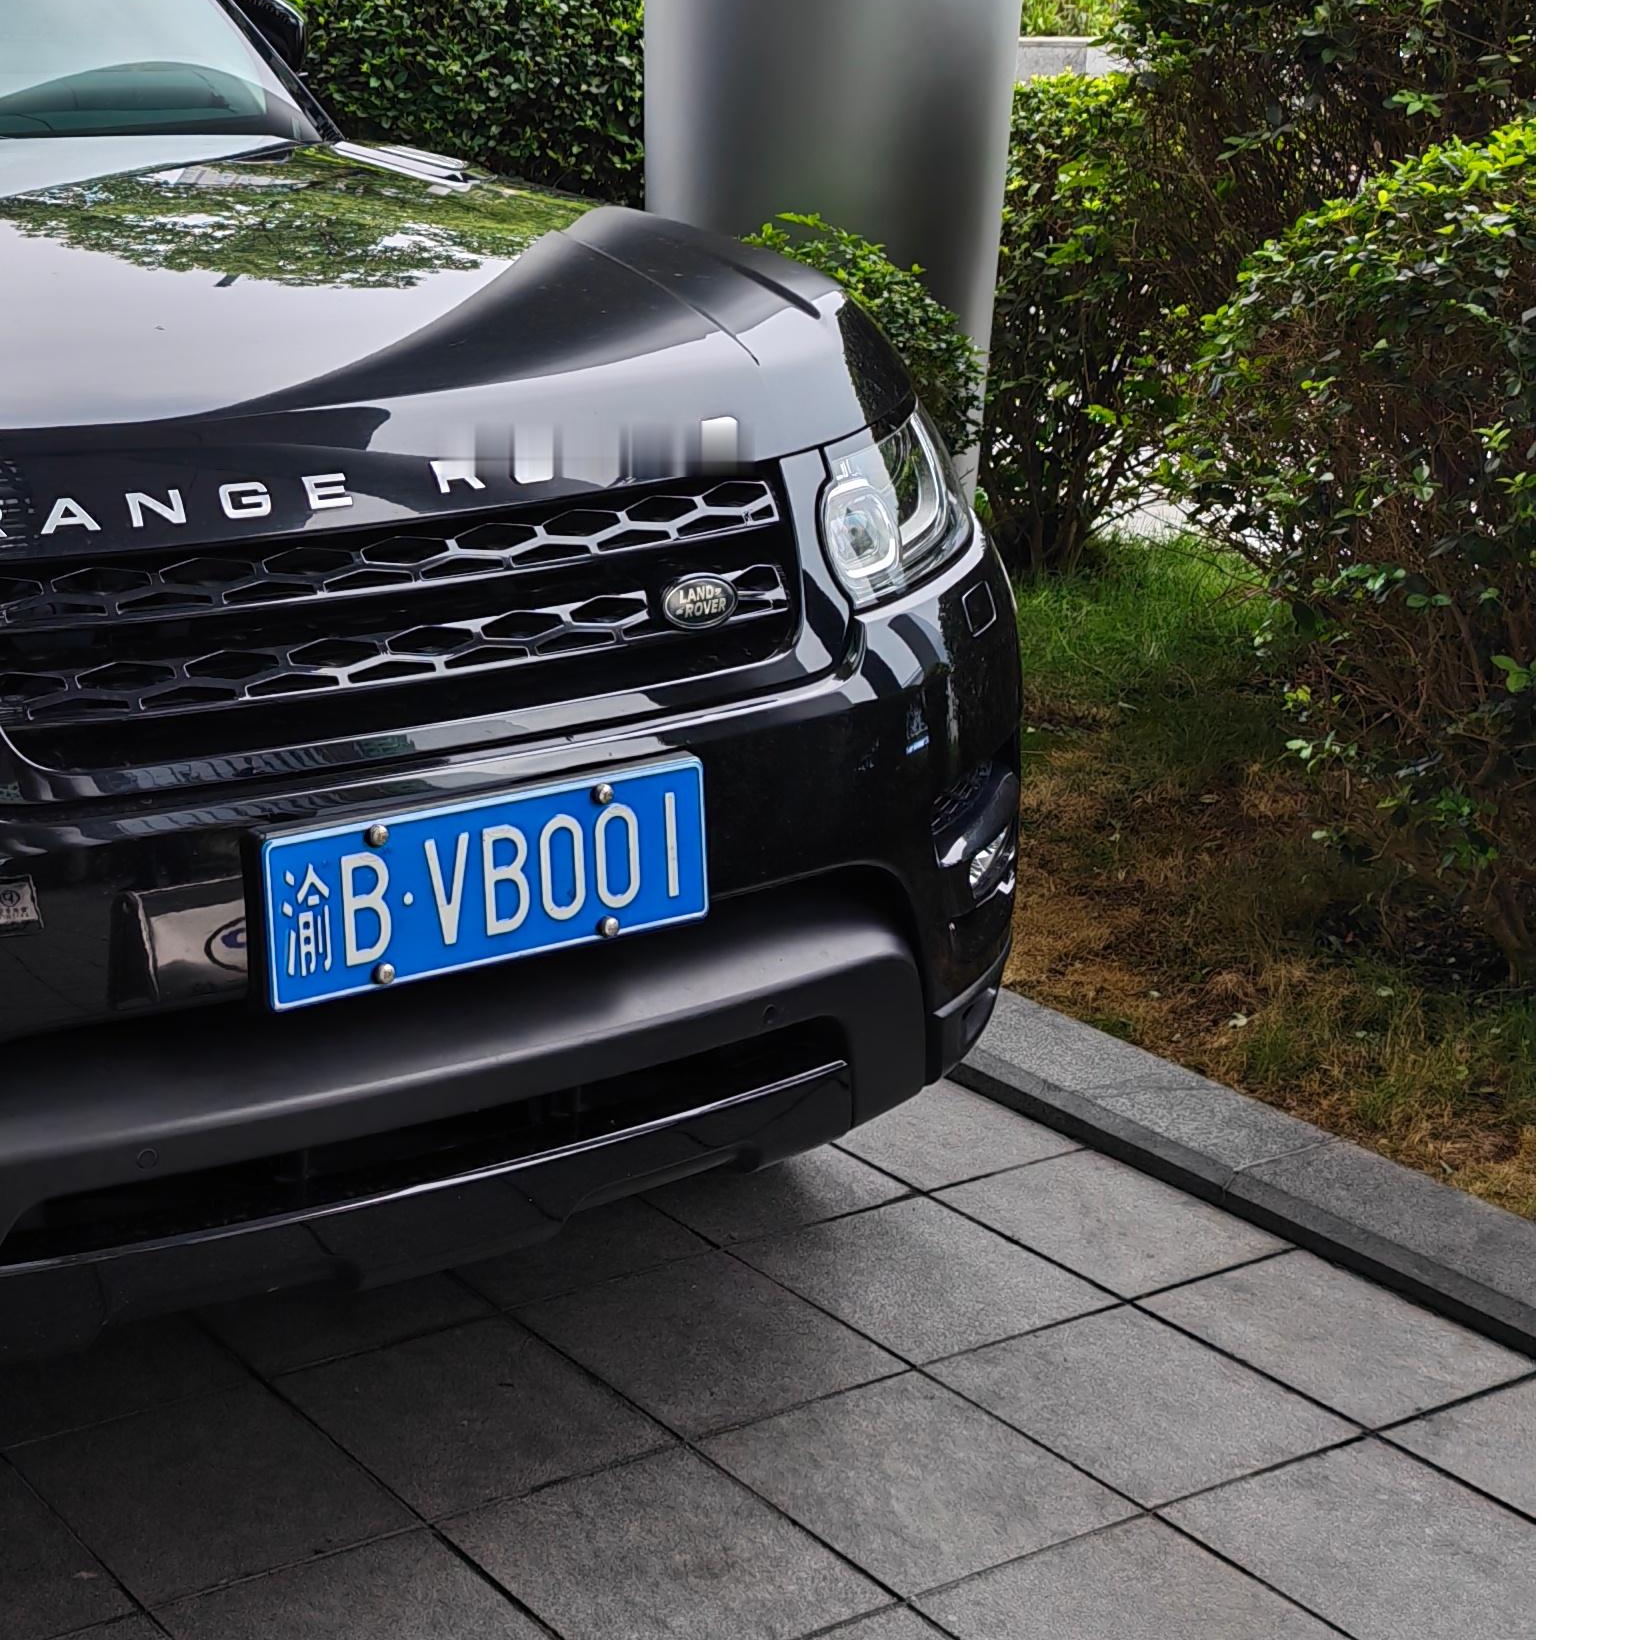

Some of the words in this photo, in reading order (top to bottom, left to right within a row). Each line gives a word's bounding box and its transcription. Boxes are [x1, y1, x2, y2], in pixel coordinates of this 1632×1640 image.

[679, 585, 714, 604] LAND
[684, 598, 726, 618] ROVER
[281, 791, 680, 977] 渝B·VB001
